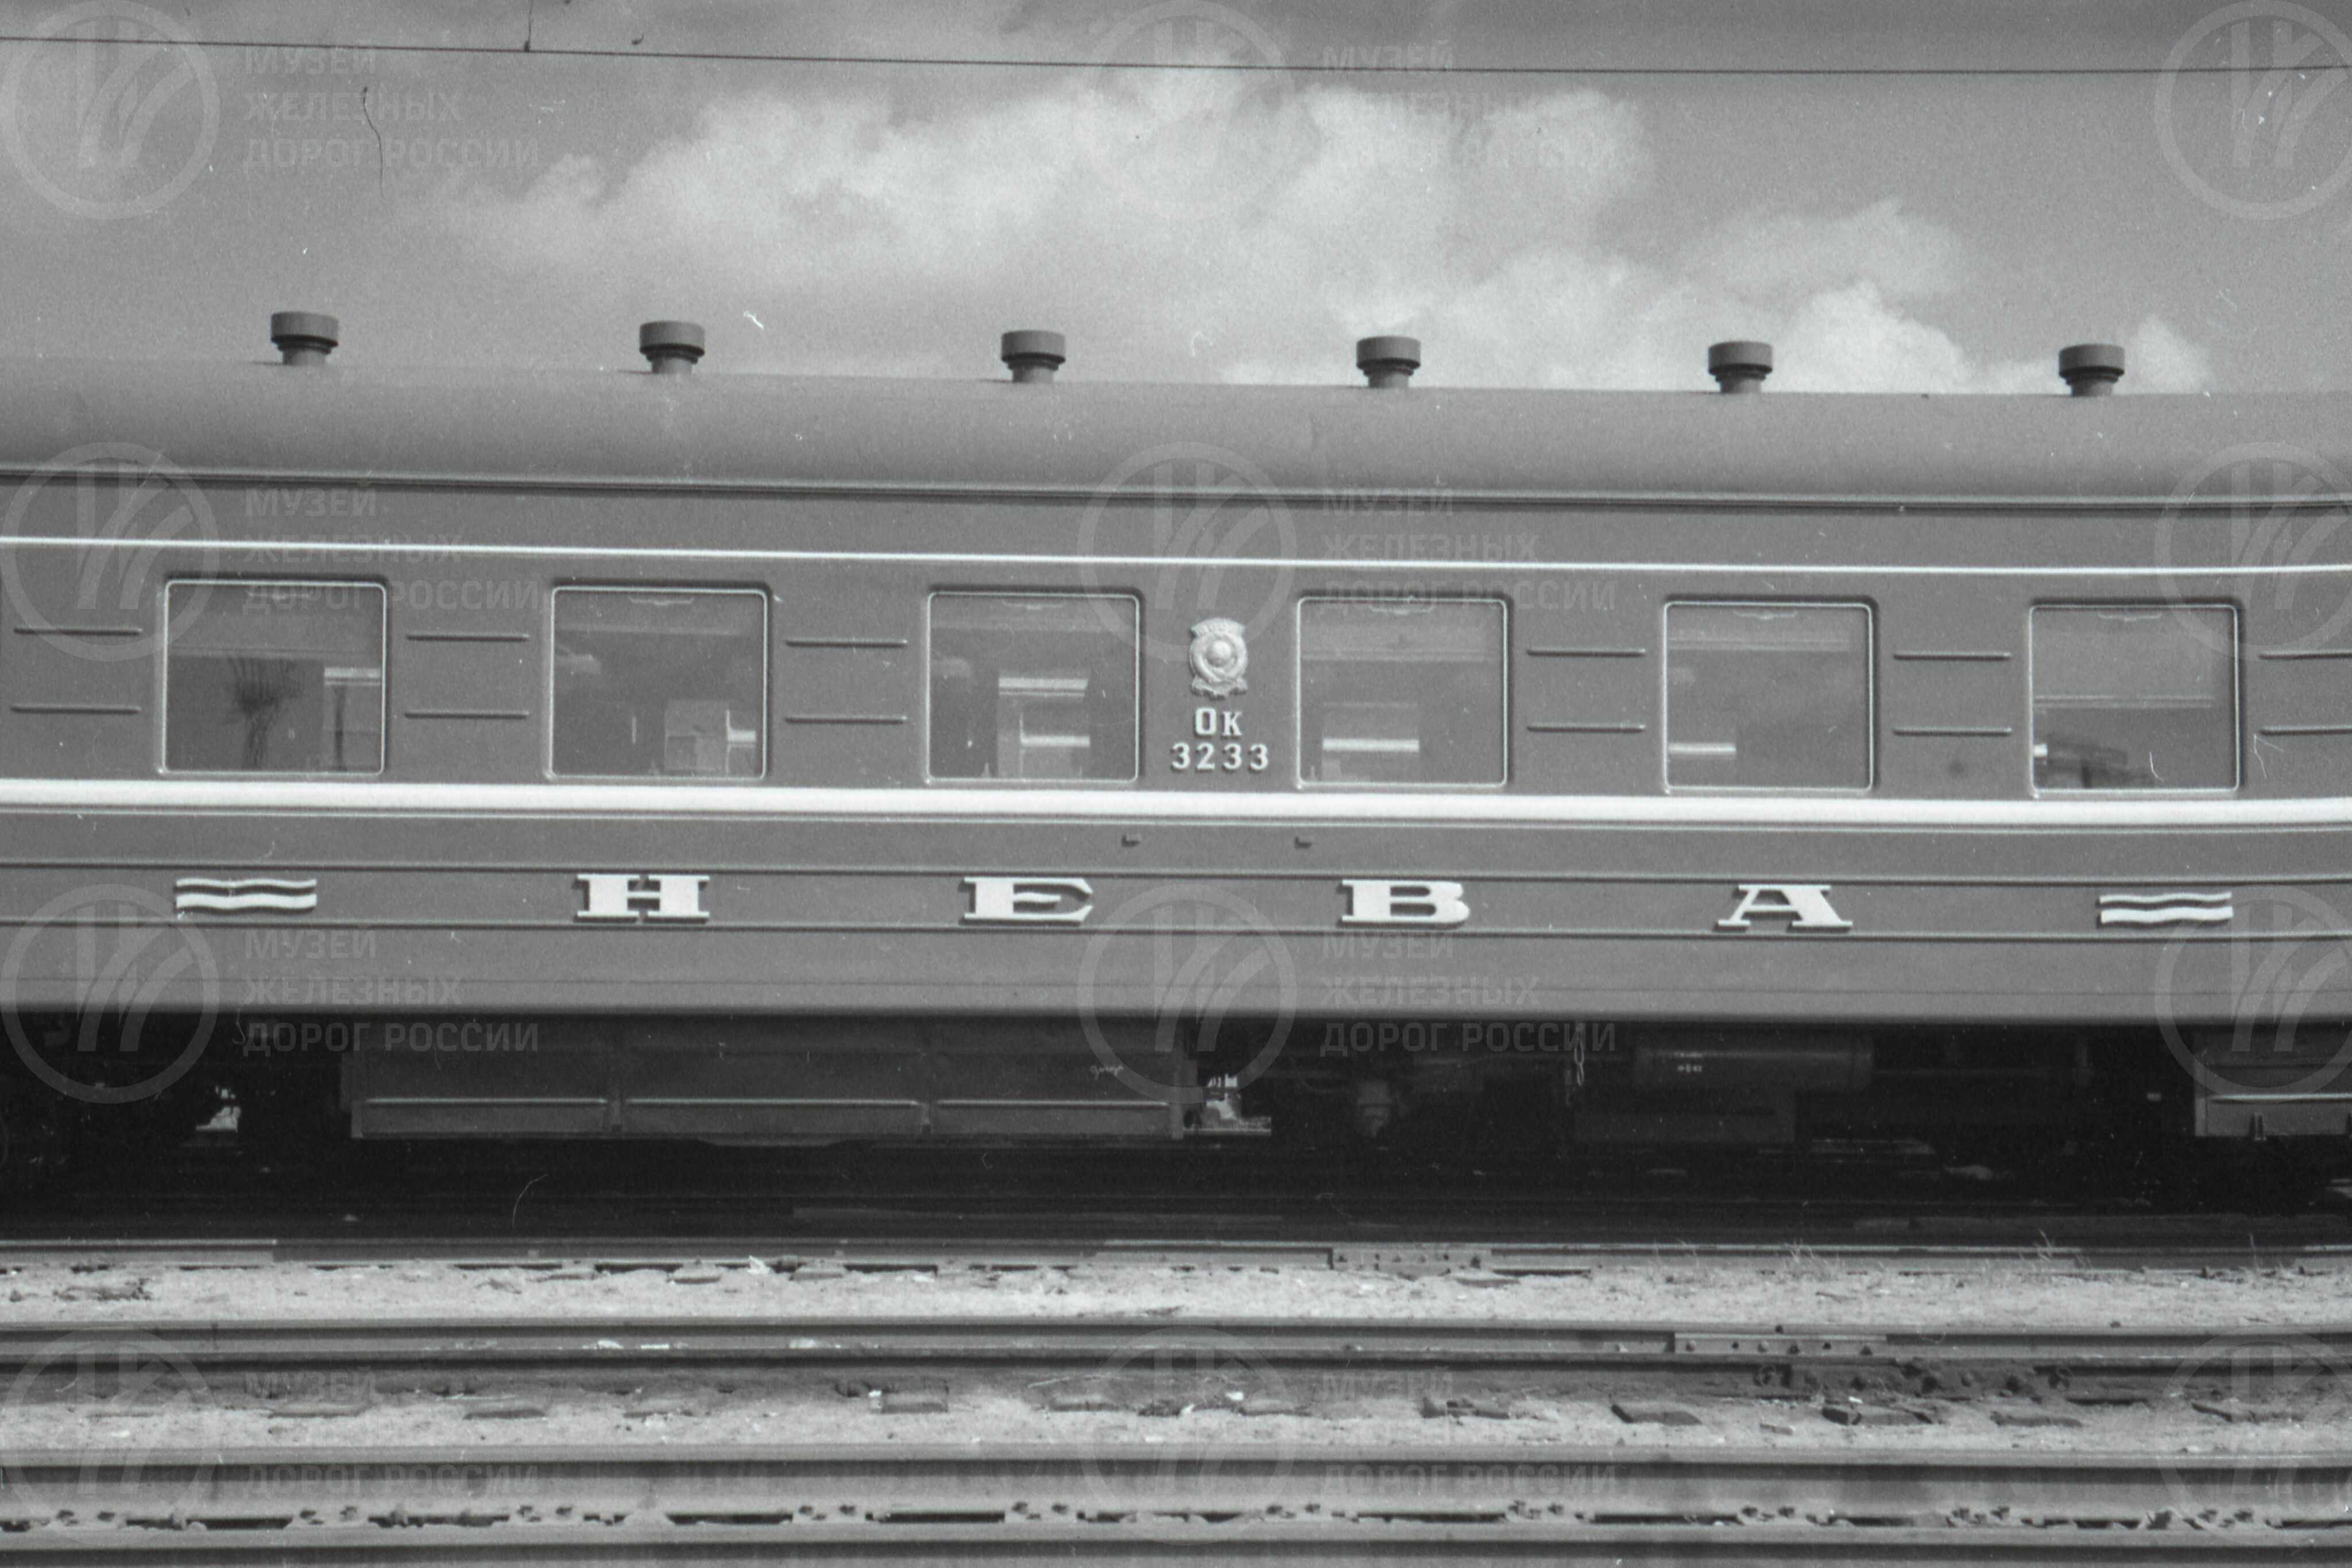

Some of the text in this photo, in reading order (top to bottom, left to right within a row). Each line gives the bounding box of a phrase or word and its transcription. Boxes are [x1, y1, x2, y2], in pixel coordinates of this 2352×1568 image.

[1195, 707, 1243, 736] ОК
[1171, 742, 1268, 771] 3233
[577, 874, 1853, 927] НЕВА
